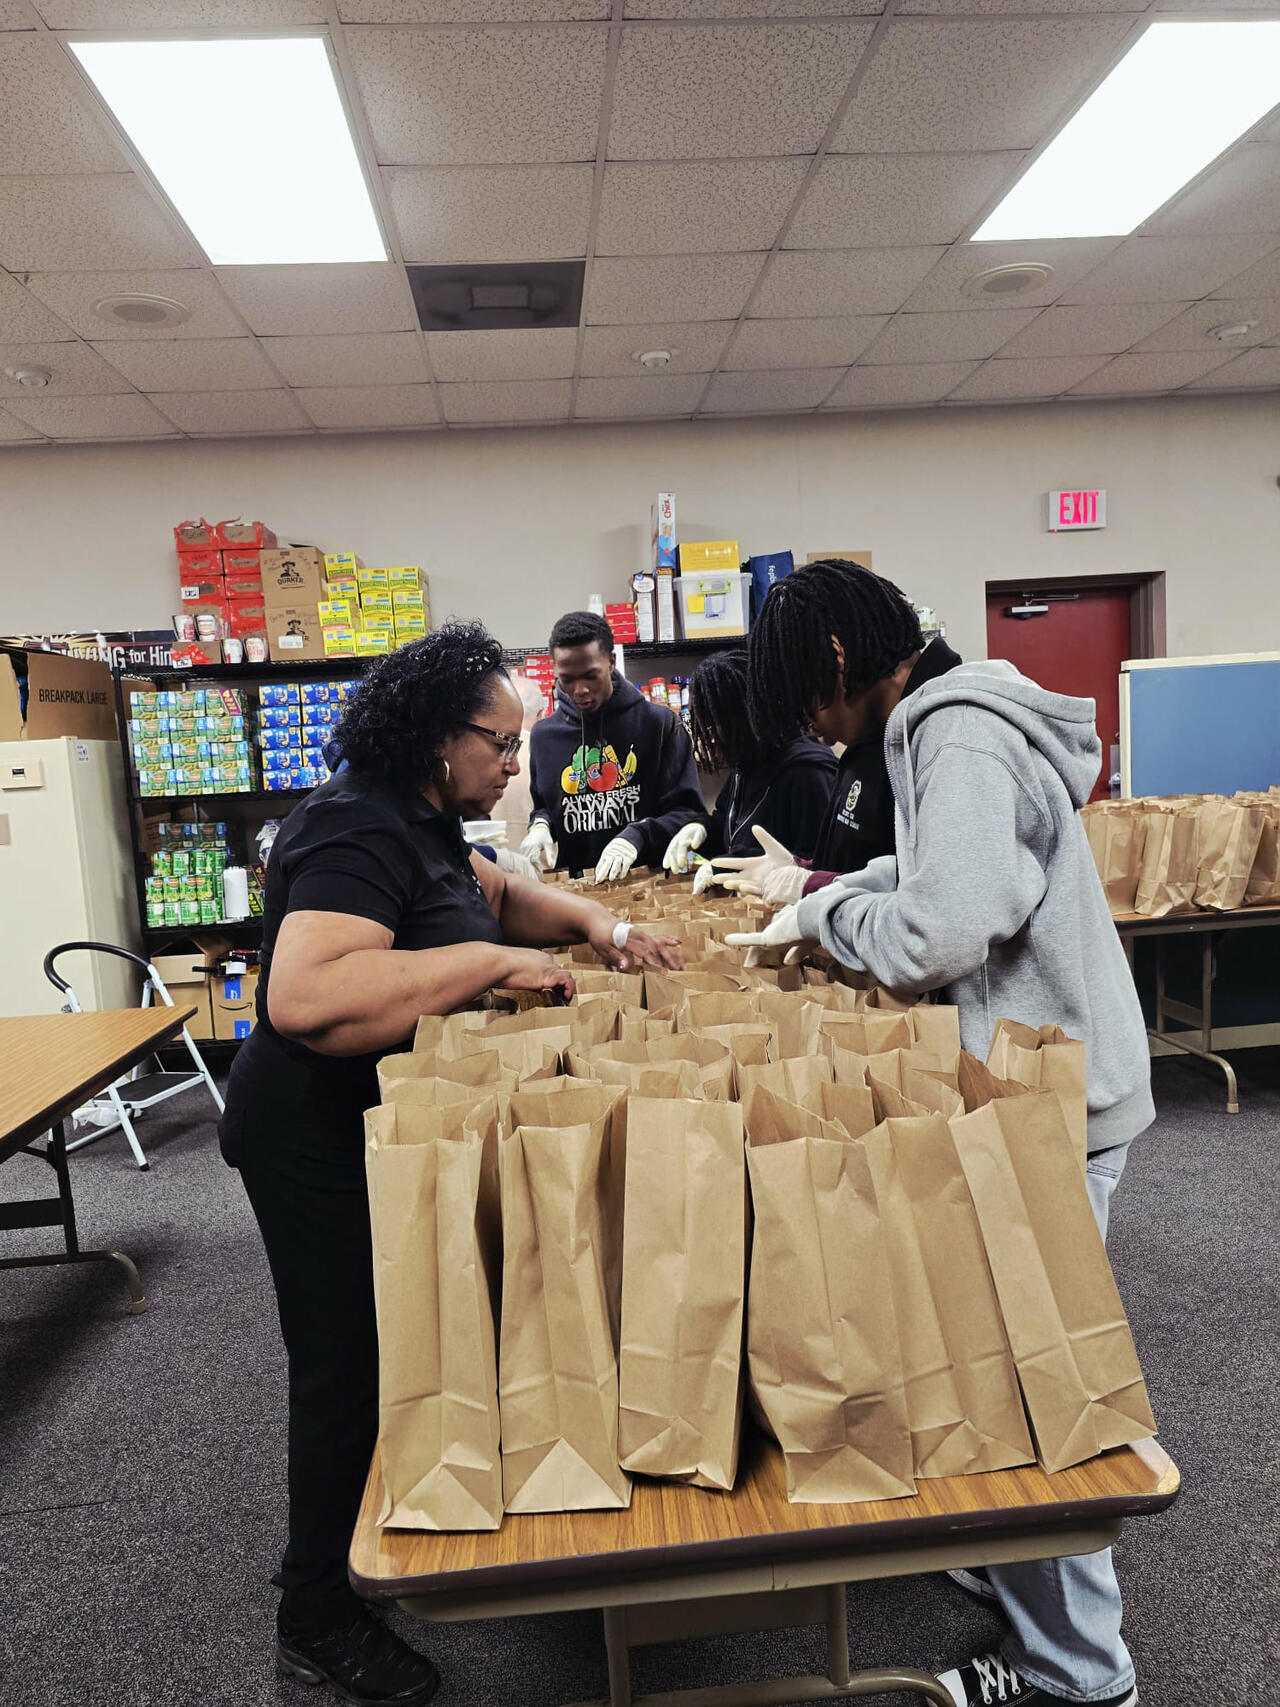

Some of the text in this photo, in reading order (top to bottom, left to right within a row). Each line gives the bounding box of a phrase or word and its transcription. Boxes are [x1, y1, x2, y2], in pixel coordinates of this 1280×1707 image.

[1059, 491, 1099, 524] EXIT
[277, 576, 305, 585] QUAKER
[128, 649, 147, 663] for
[39, 688, 109, 706] BREAKPACK LARGE
[562, 784, 641, 807] ALWAYS FRESH
[564, 792, 641, 816] ALWAYS
[563, 803, 638, 834] ORIGINAL
